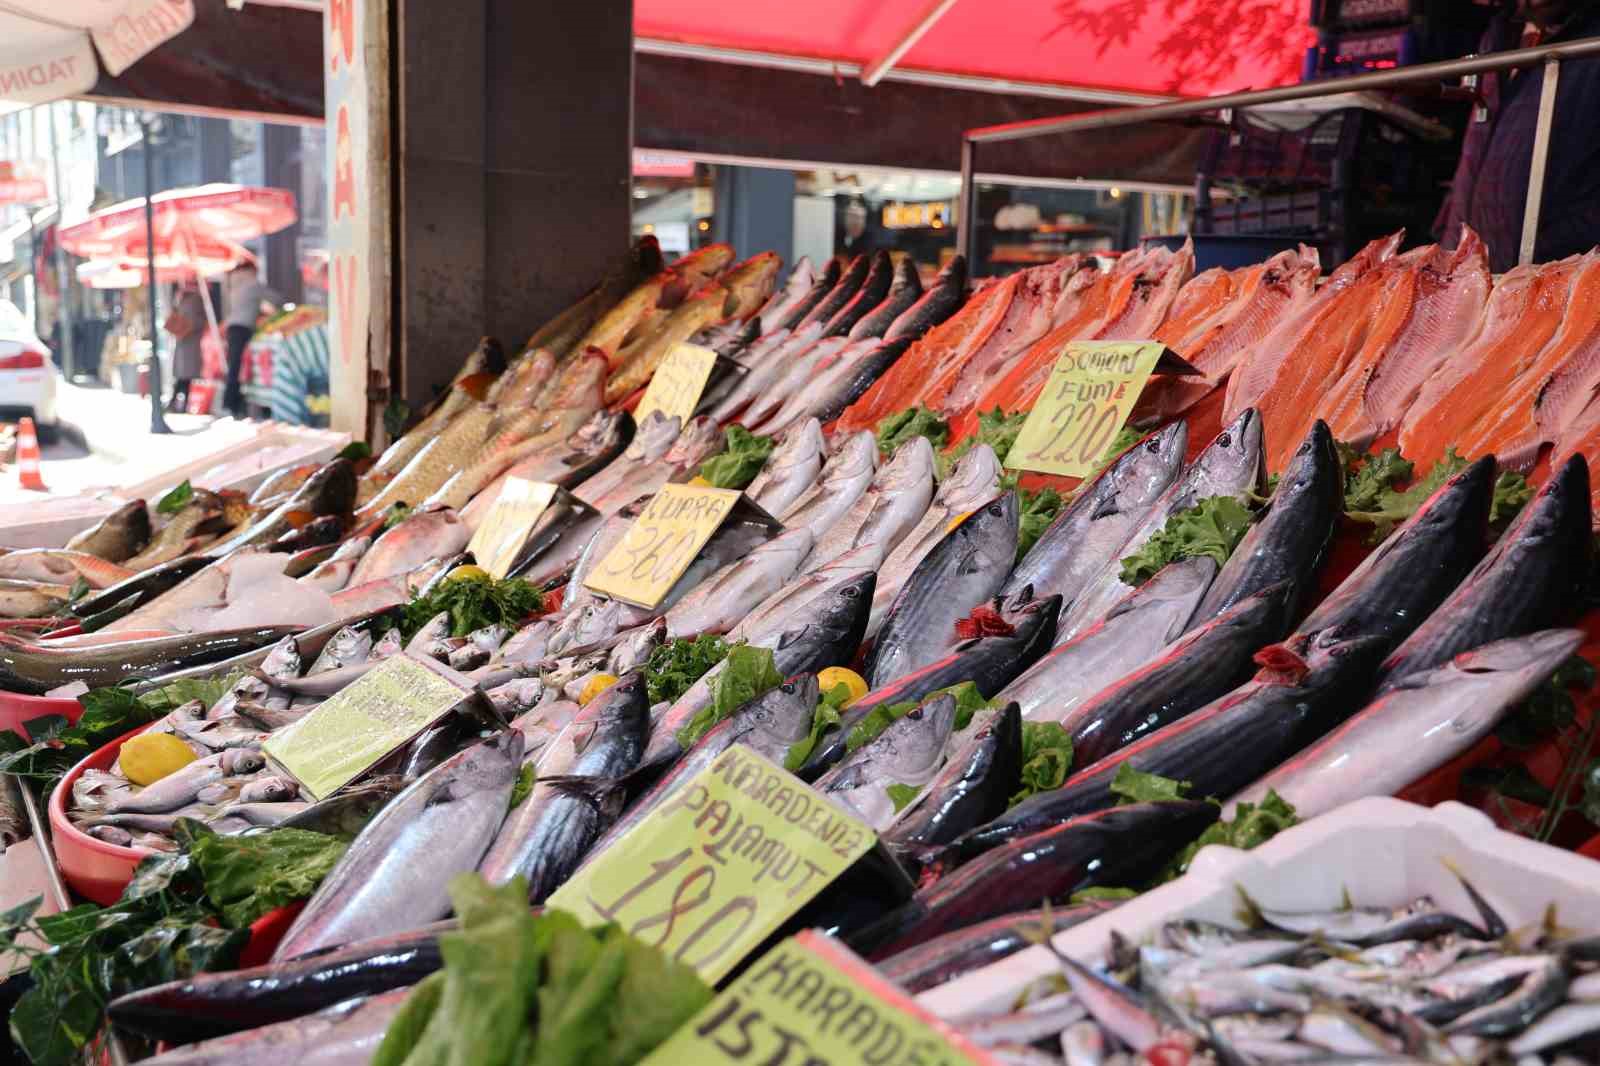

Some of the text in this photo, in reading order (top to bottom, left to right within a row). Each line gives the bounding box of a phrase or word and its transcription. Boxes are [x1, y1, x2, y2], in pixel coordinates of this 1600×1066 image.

[1026, 402, 1119, 465] 220
[605, 526, 697, 585] 360
[661, 783, 829, 899] PALAMUT
[585, 847, 759, 972] 180
